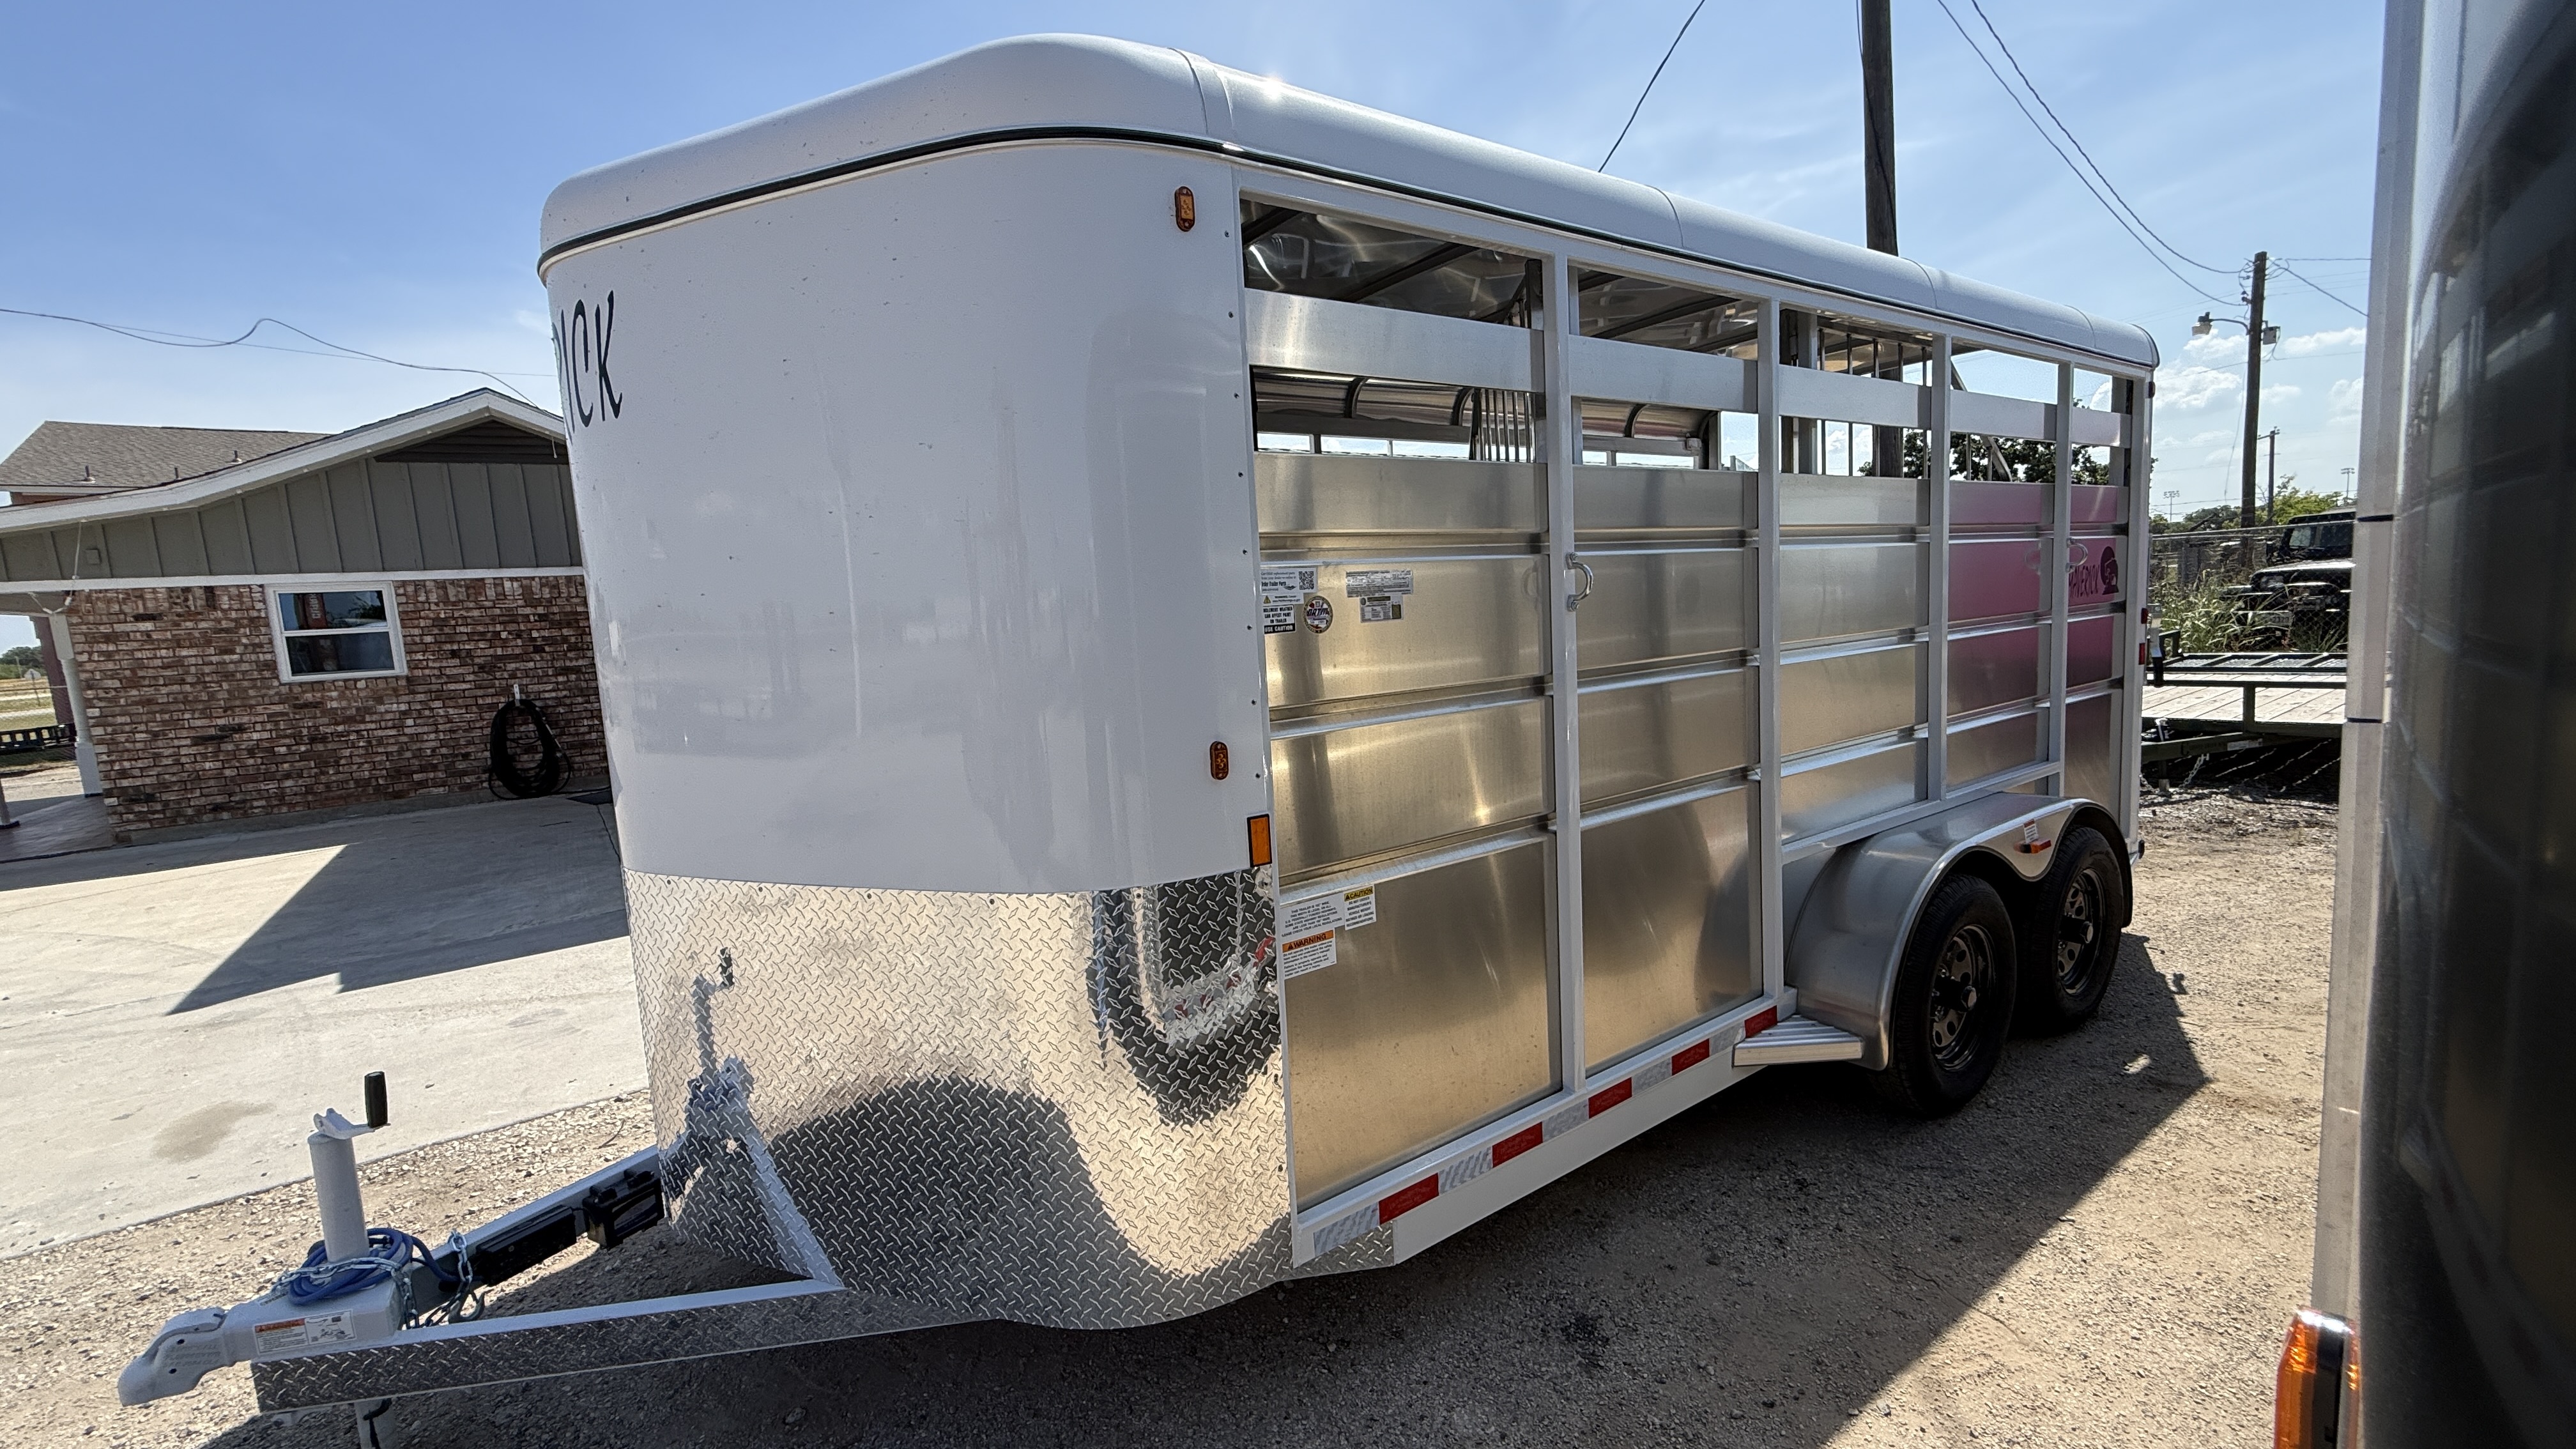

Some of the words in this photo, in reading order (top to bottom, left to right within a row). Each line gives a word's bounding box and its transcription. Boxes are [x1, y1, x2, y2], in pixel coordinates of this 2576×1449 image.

[552, 289, 623, 446] ICK
[1350, 888, 1373, 898] CAUTION
[1293, 933, 1326, 947] WARNING
